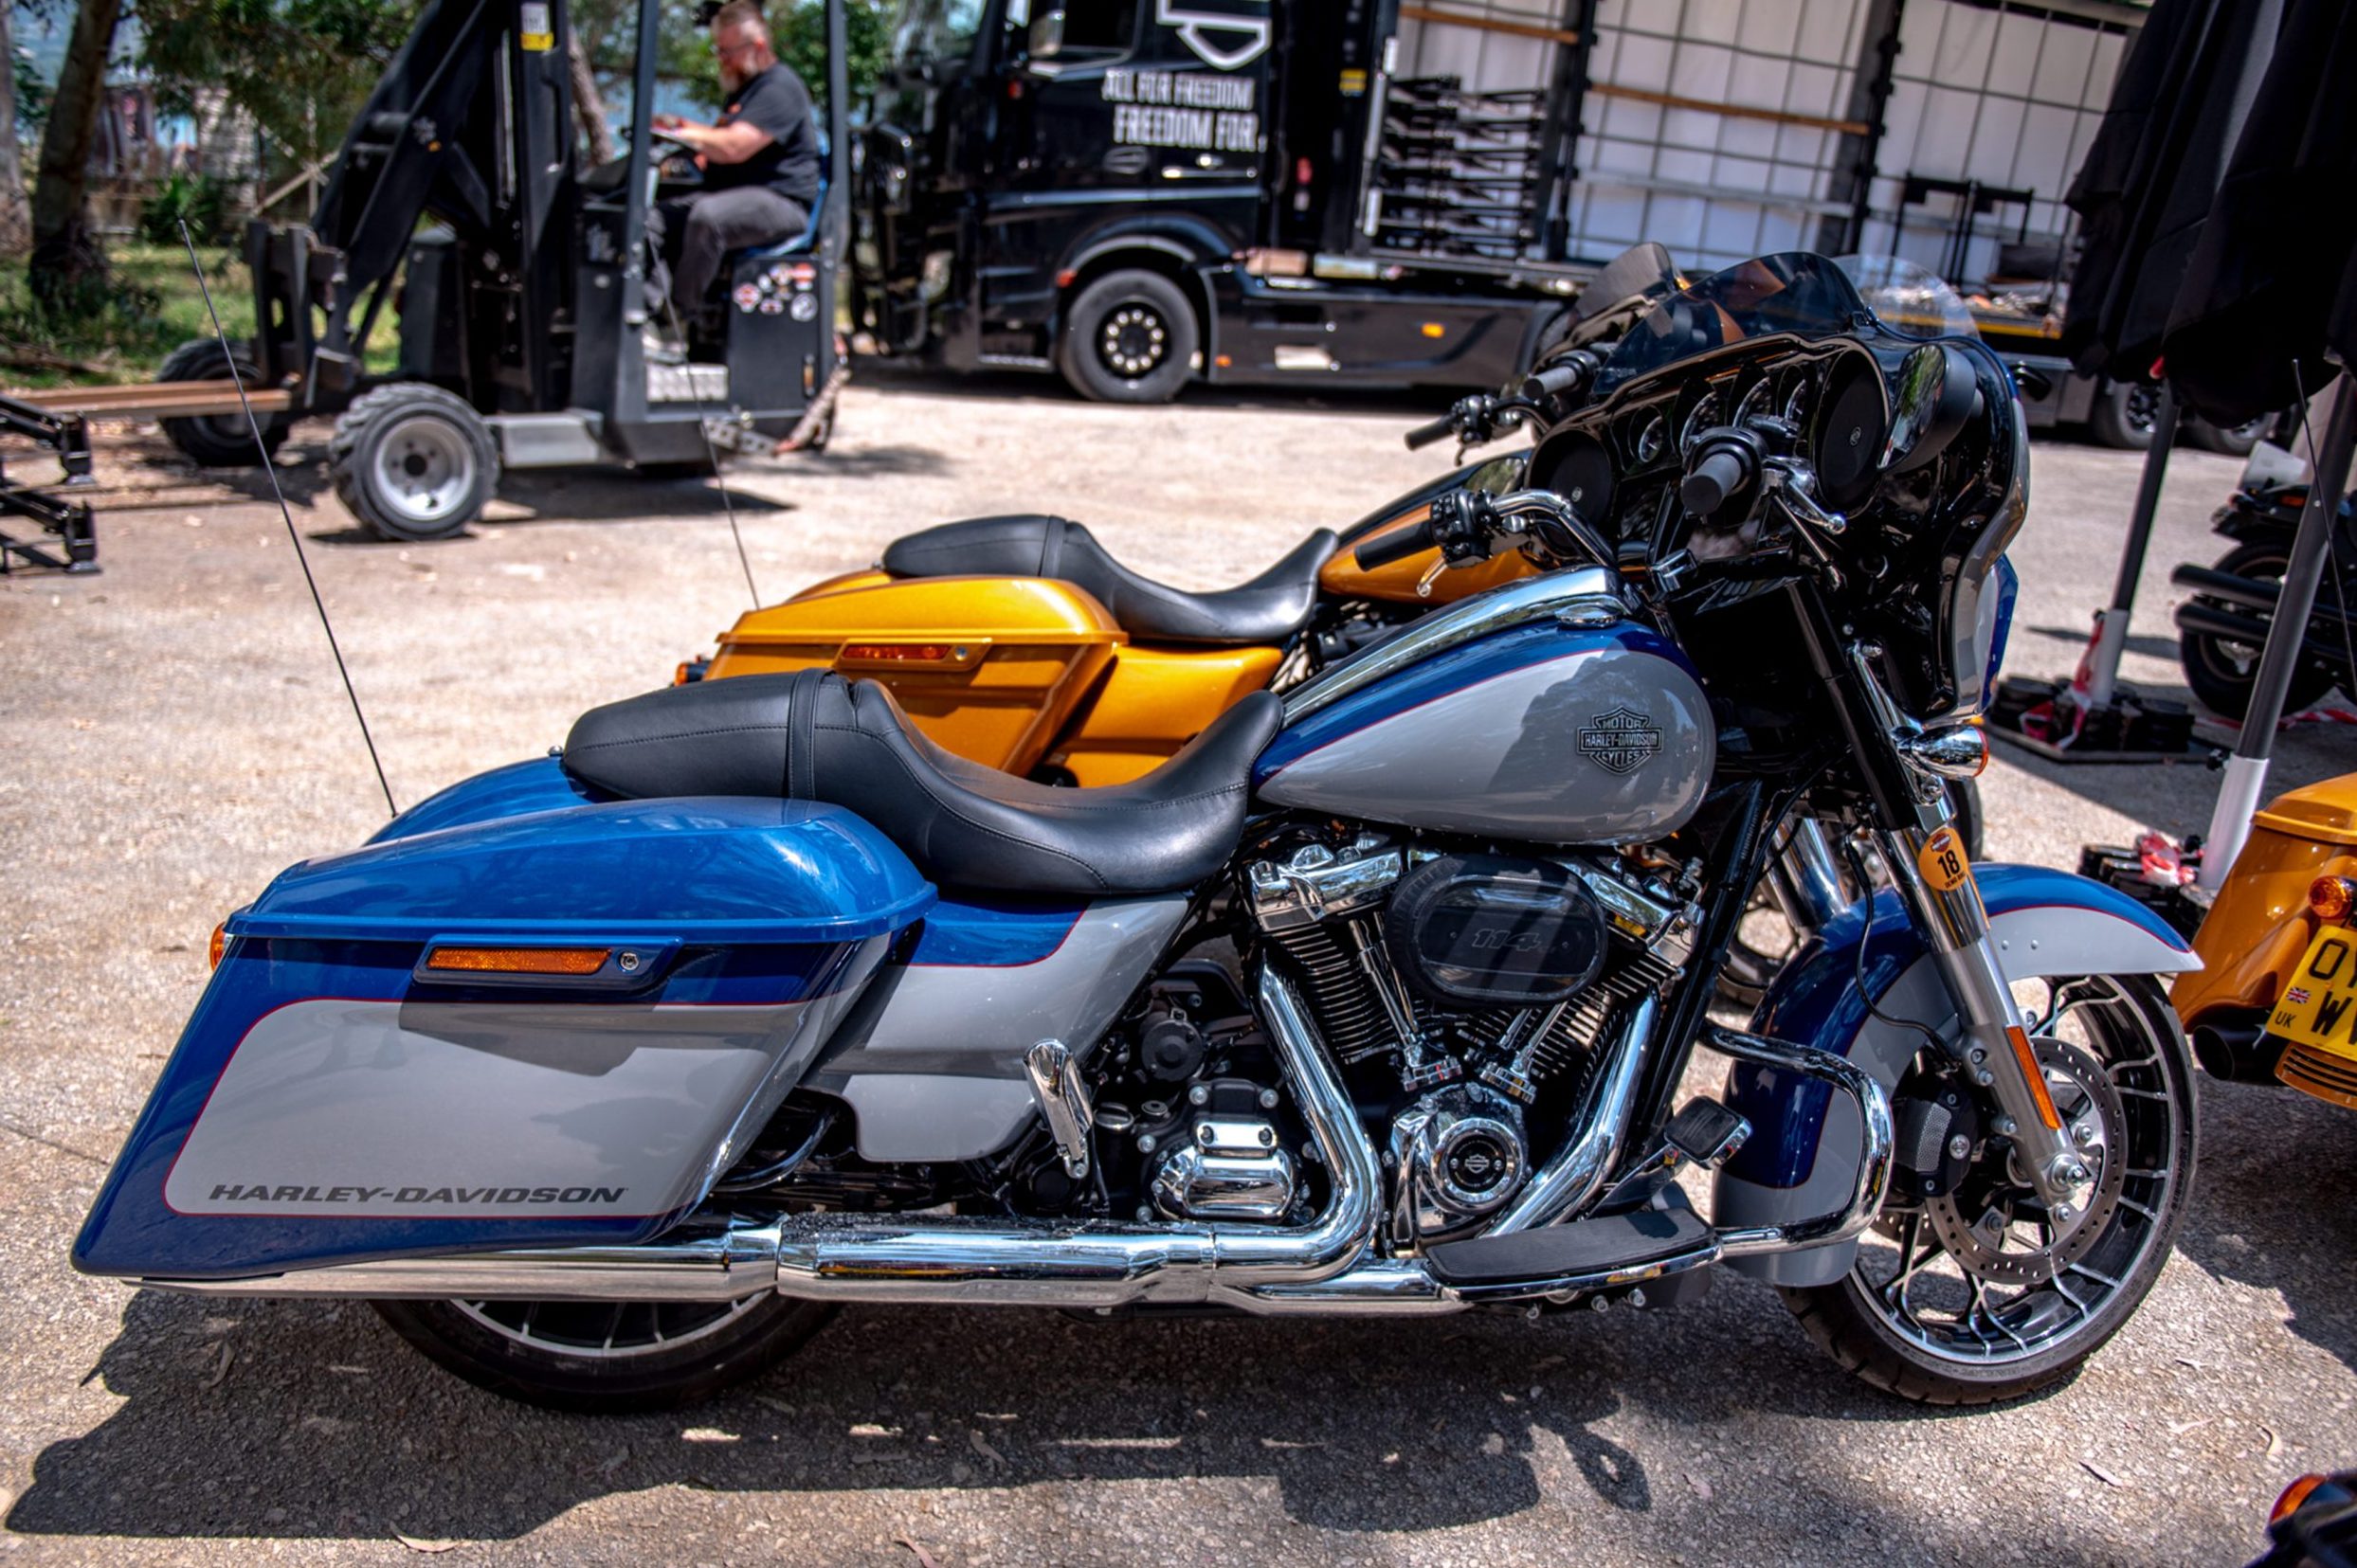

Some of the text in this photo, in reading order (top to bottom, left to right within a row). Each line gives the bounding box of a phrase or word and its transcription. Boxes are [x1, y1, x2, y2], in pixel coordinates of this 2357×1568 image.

[1102, 67, 1255, 110] ALL FOR FREEDOM
[1114, 103, 1214, 148] FREEDOM
[1602, 712, 1642, 729] MOTOR
[1584, 730, 1658, 748] HARLEY-DAVIDSON
[1601, 750, 1641, 766] CYCLES
[1936, 849, 1961, 879] 18
[1471, 928, 1542, 952] 114
[2275, 1010, 2296, 1029] UK
[209, 1183, 626, 1204] HARLEY-DAVIDSON
